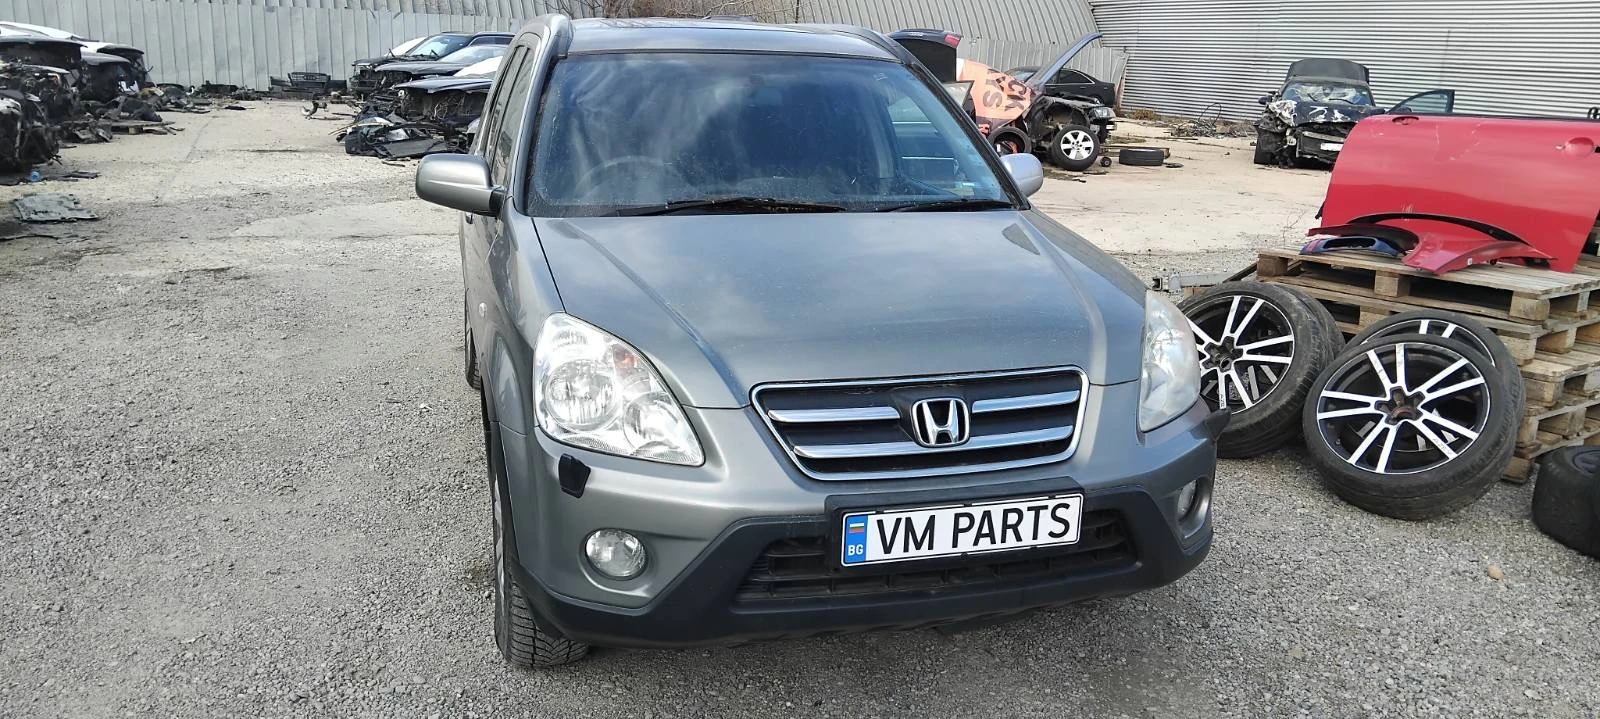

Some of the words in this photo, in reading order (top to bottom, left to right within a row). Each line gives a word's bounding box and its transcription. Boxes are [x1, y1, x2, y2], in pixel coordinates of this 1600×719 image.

[877, 515, 936, 554] VM
[952, 502, 1071, 548] PARTS
[847, 544, 864, 556] BG
